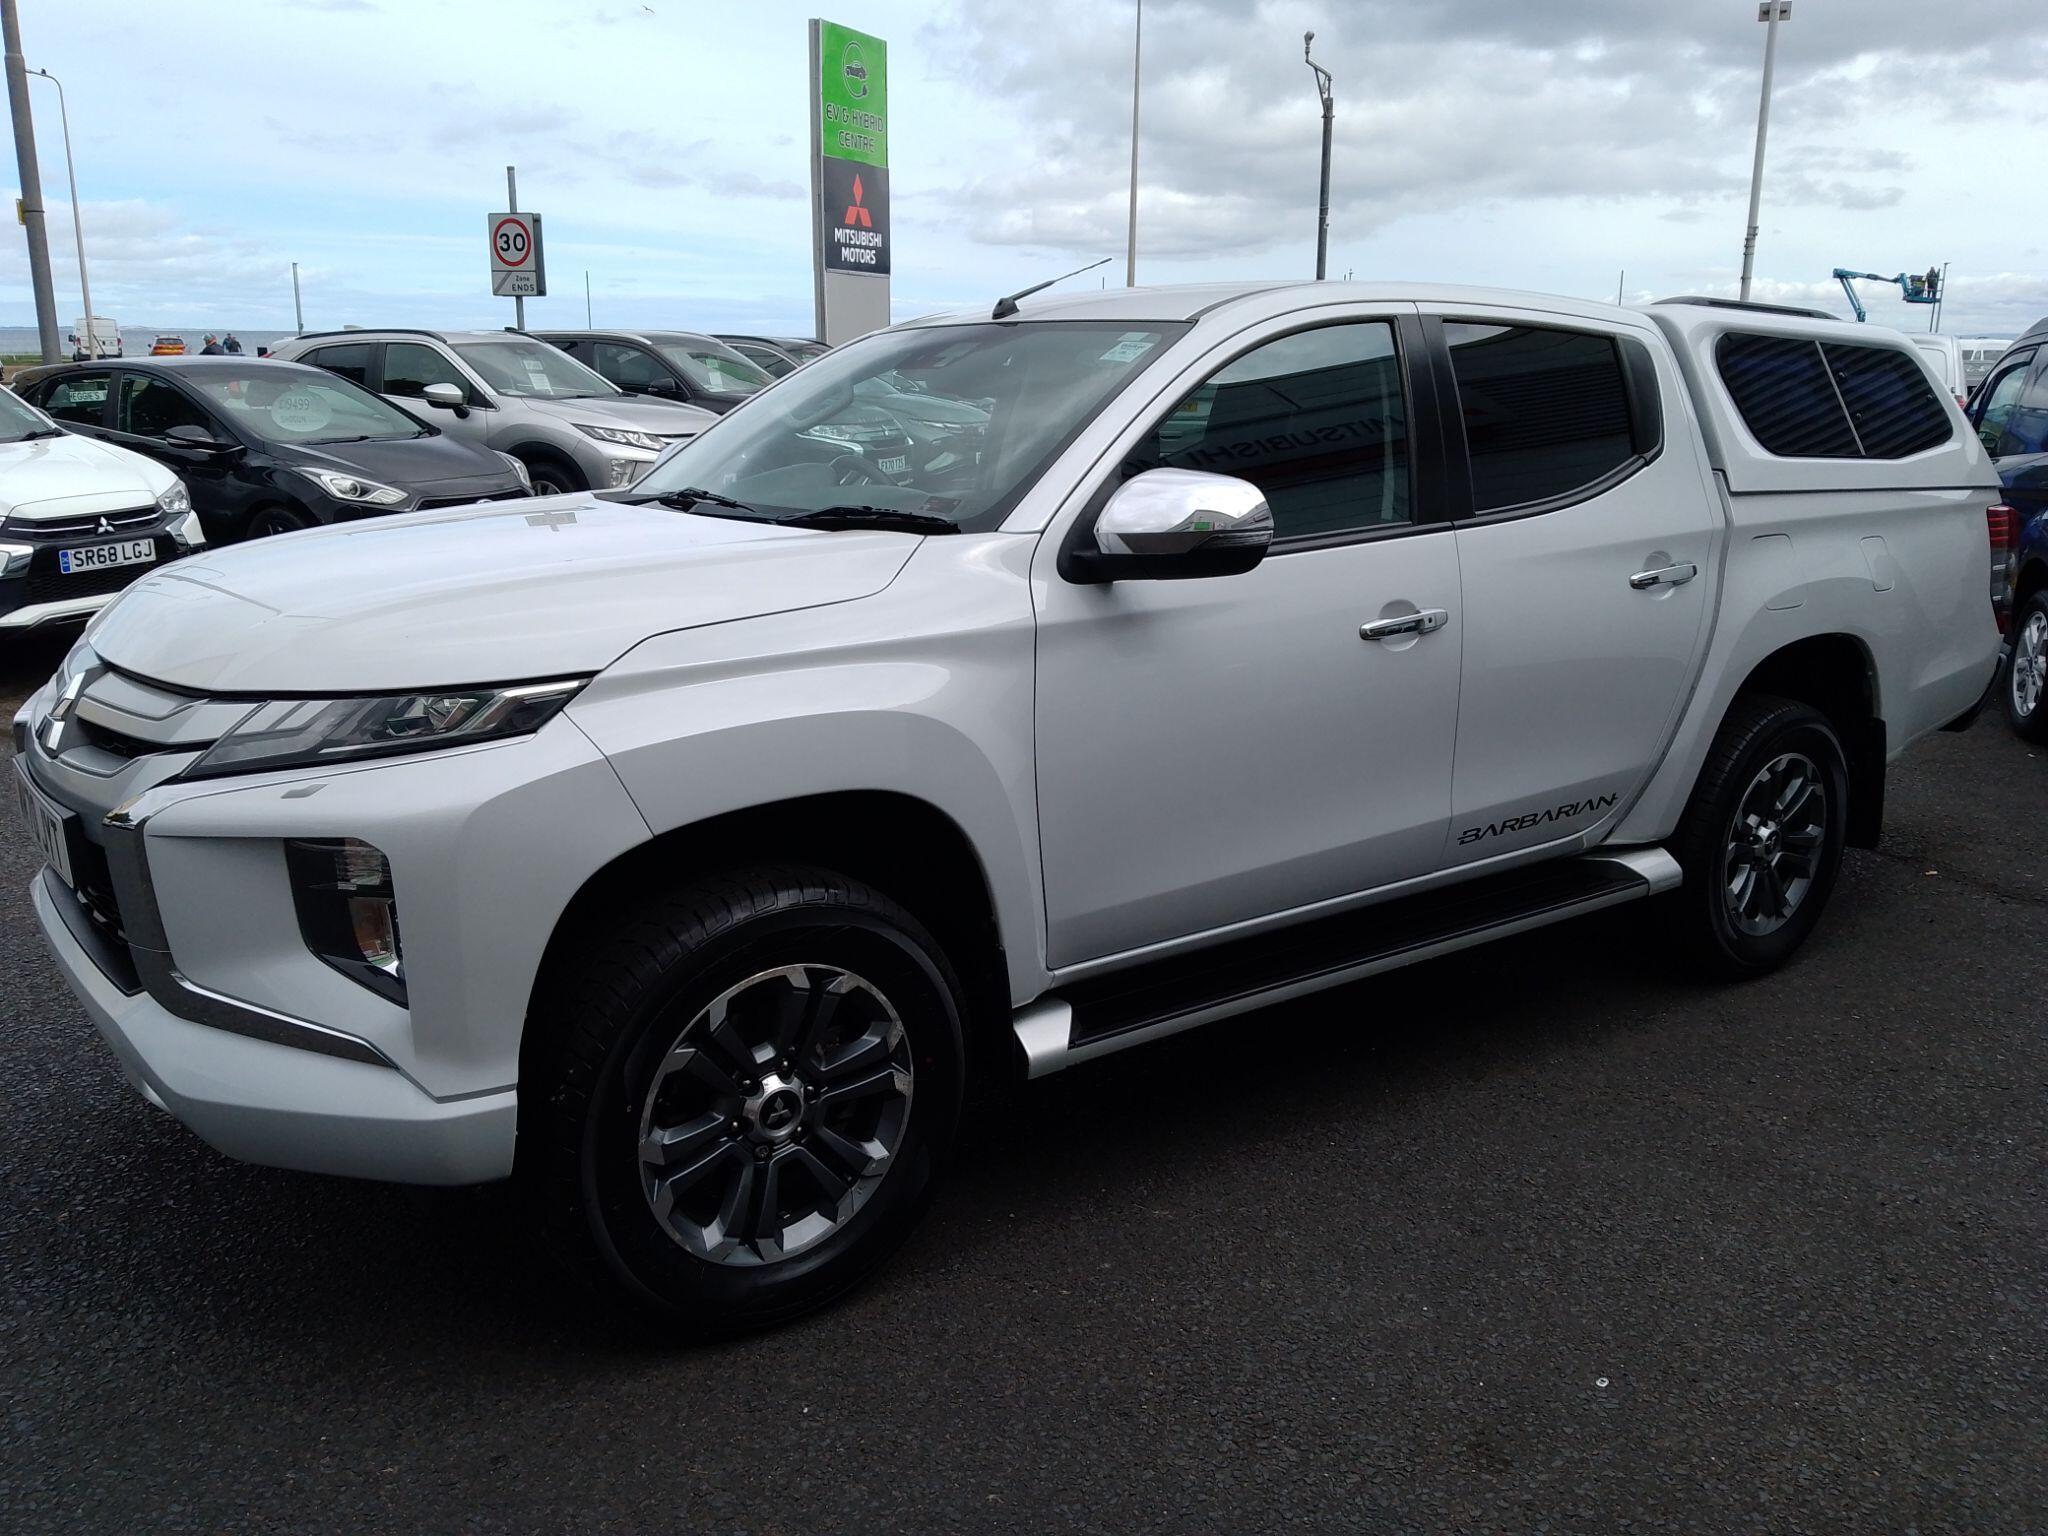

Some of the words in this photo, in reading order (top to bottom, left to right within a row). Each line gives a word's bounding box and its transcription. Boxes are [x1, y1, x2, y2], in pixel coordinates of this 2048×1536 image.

[826, 103, 840, 121] EV
[841, 107, 850, 124] &
[852, 109, 884, 132] HYBRID
[838, 130, 875, 153] CENTRE
[499, 233, 526, 252] 30
[834, 227, 882, 248] MITSUBISHI
[841, 246, 876, 265] MOTORS
[511, 283, 535, 292] ENDS
[73, 546, 118, 567] SR68
[122, 540, 152, 561] LGJ
[1457, 792, 1618, 846] BARBARIAN
